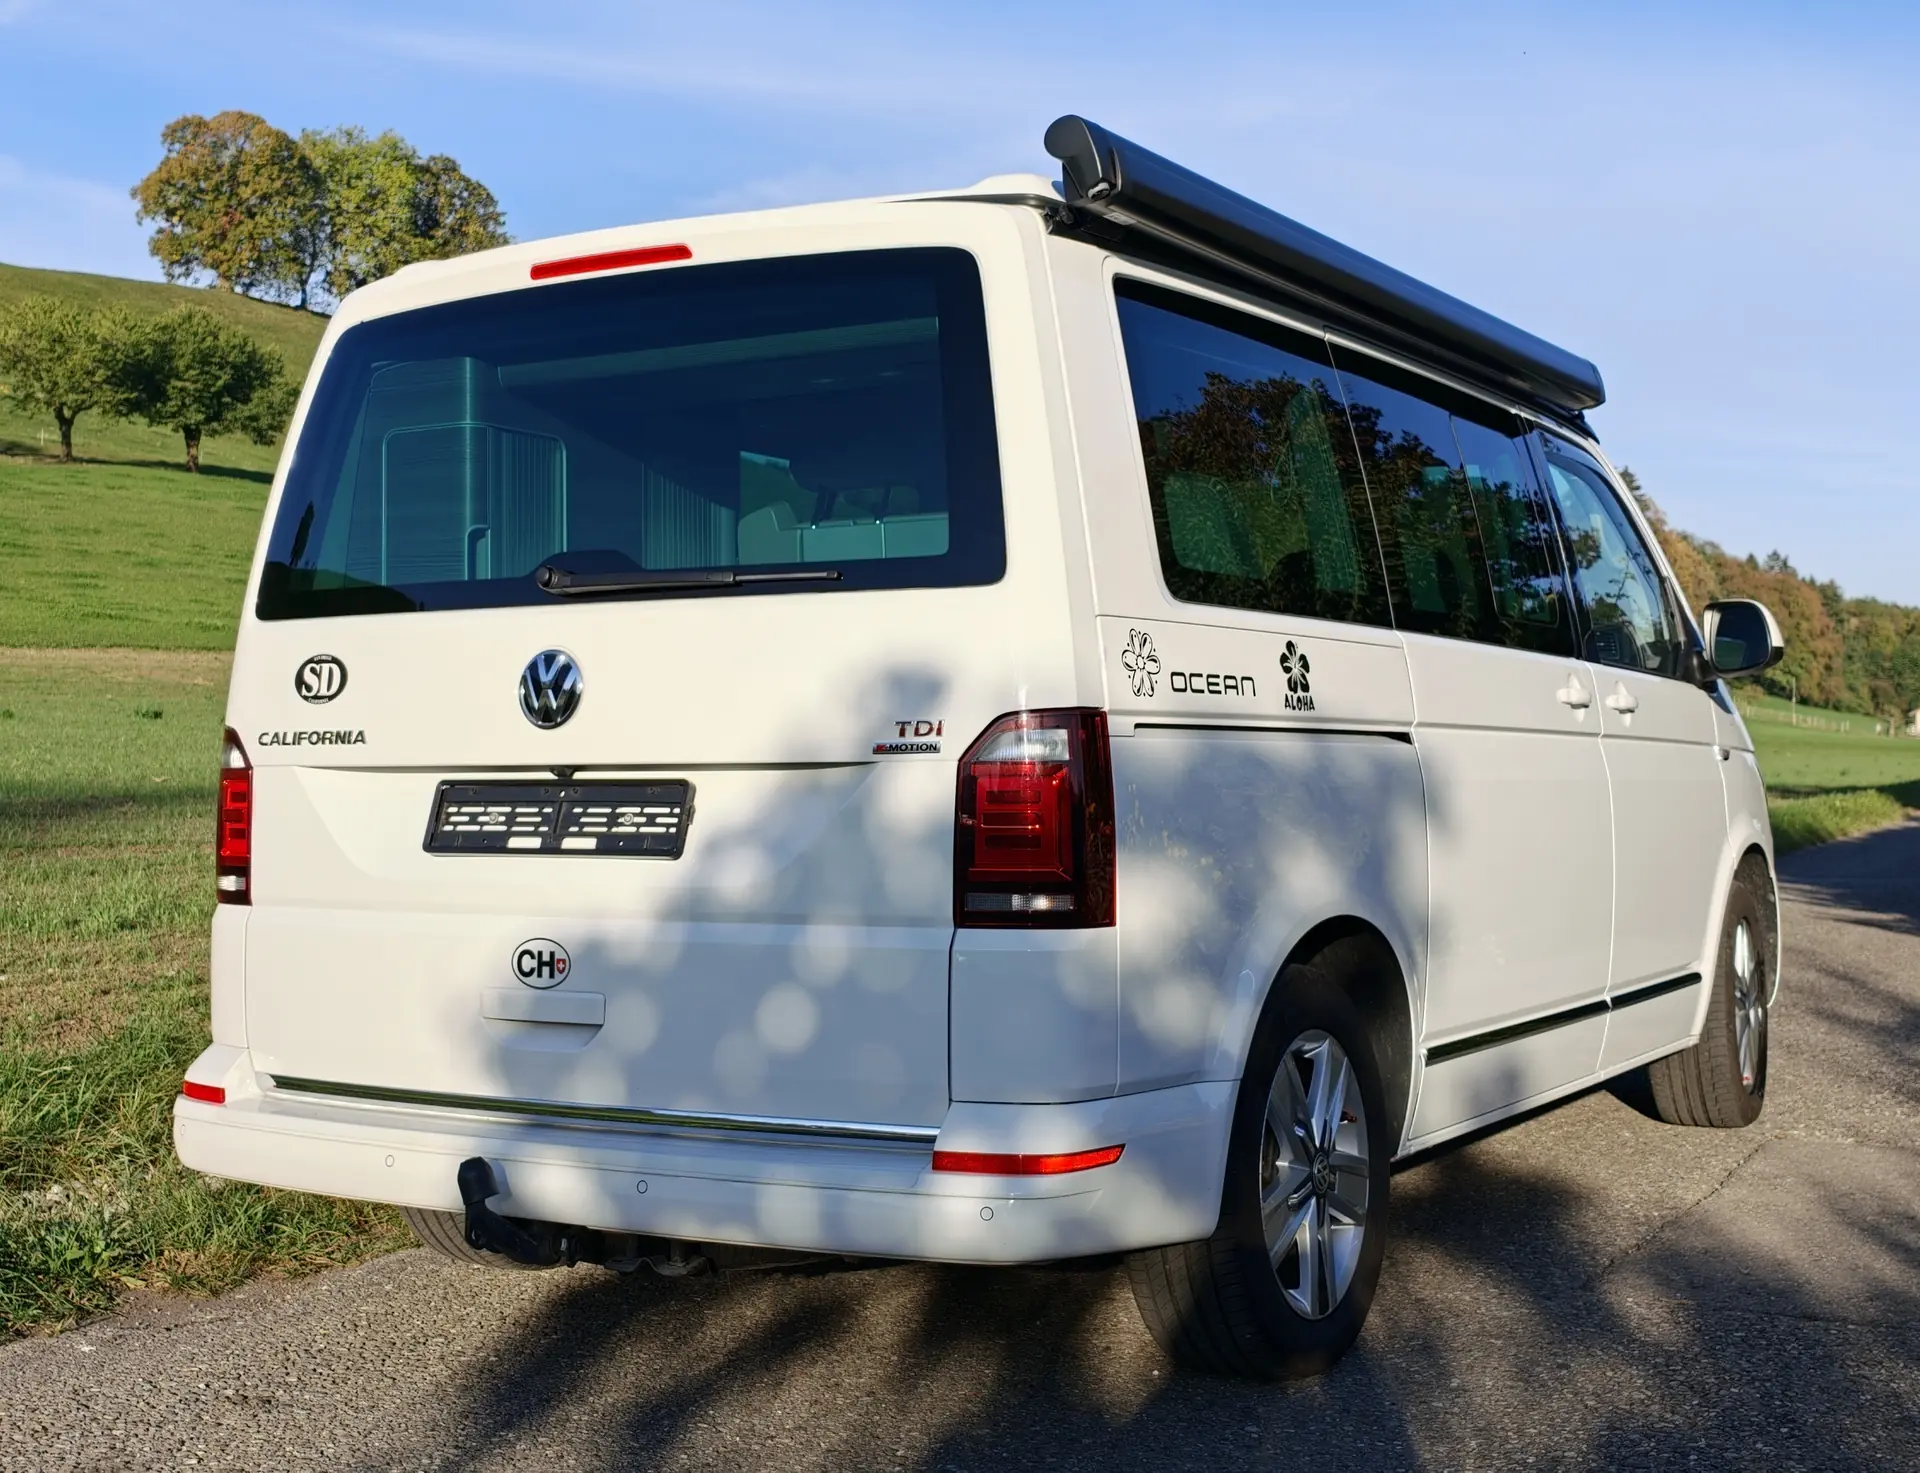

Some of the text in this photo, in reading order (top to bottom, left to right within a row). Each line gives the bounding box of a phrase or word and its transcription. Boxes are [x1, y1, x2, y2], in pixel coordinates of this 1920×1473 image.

[301, 662, 341, 697] SD
[1170, 671, 1257, 697] OCEAN
[1284, 693, 1316, 712] ALOHA
[258, 729, 367, 747] CALIFORNIA
[894, 719, 944, 738] TDI
[516, 948, 555, 979] CH
